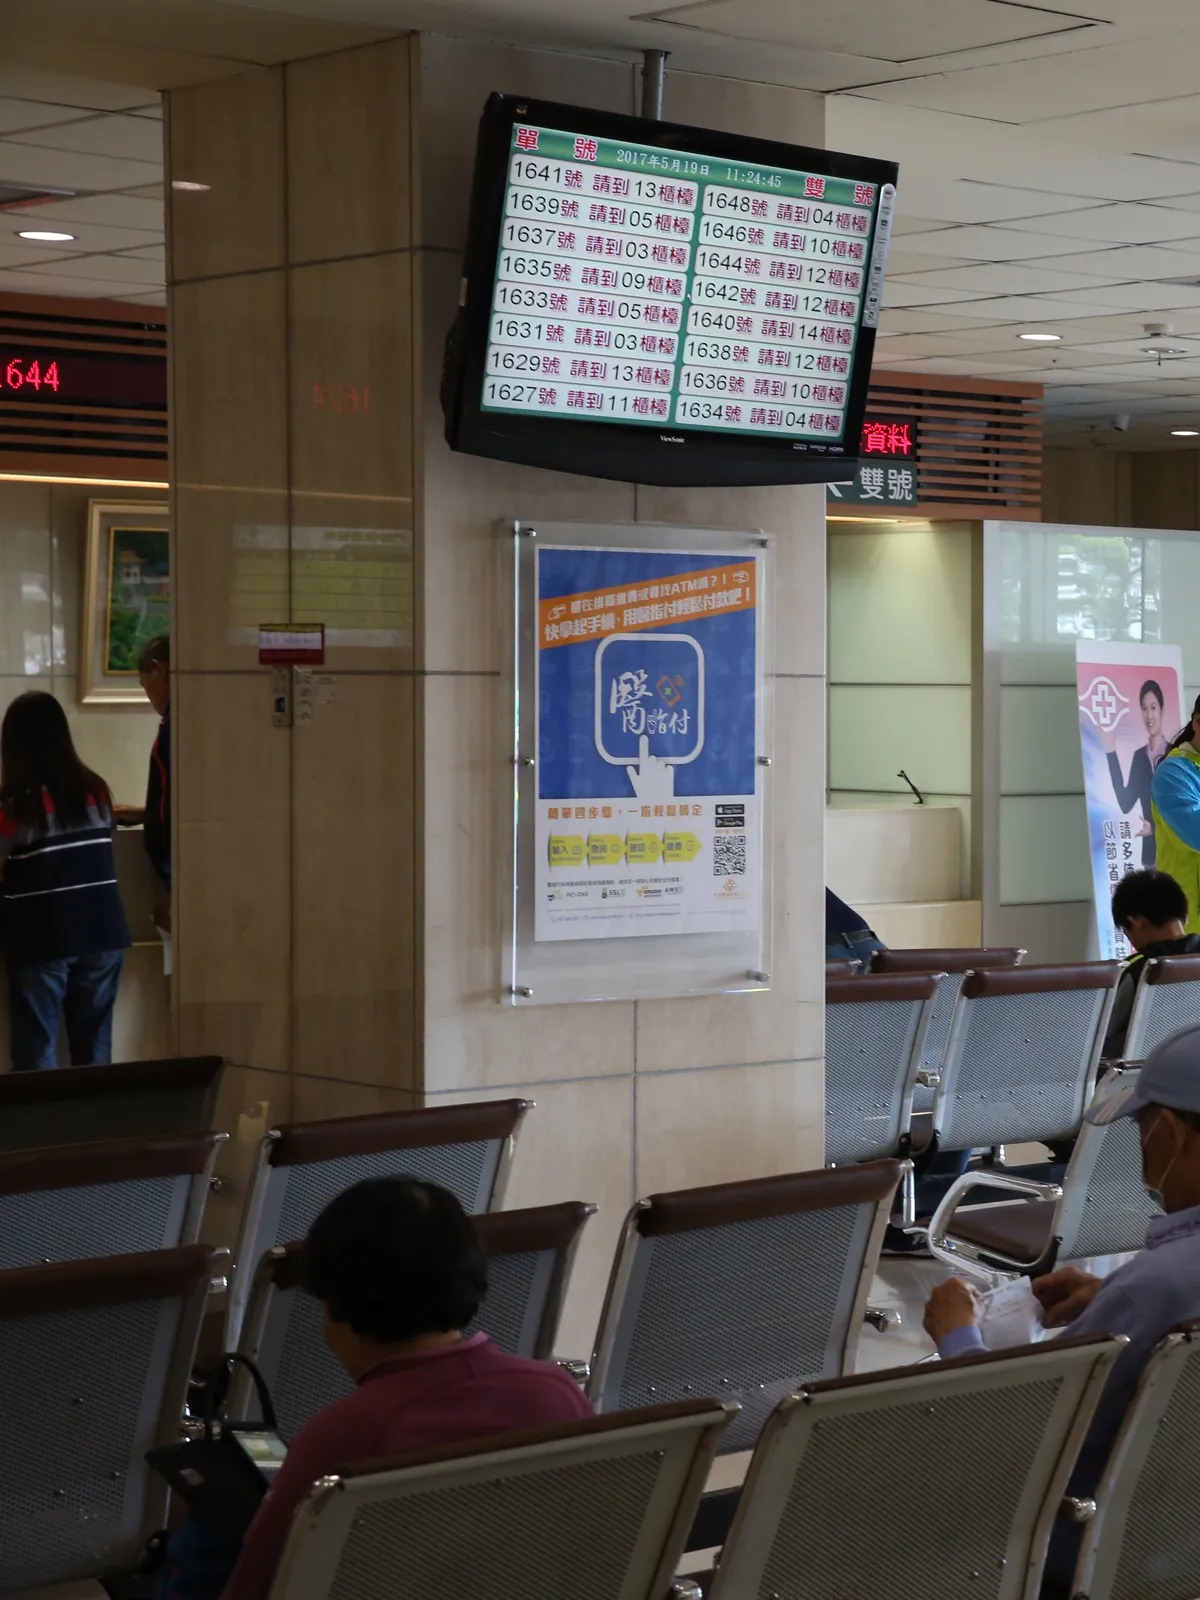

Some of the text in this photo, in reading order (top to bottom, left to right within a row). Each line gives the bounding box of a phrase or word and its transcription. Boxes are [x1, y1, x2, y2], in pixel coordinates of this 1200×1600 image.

[514, 127, 599, 162] 單號
[514, 161, 583, 189] 1641號
[617, 150, 782, 188] 2017年5月19日 11:24:45
[804, 176, 875, 206] 雙號
[510, 193, 579, 218] 1639號
[707, 192, 768, 217] 1648號
[507, 225, 576, 249] 1637號
[703, 222, 764, 245] 1646號
[503, 256, 571, 282] 1635號
[699, 252, 761, 275] 1644號
[499, 288, 567, 312] 1633號
[695, 282, 756, 305] 1642號
[495, 319, 564, 343] 1631號
[691, 311, 752, 333] 1640號
[492, 352, 560, 374] 1629號
[687, 342, 749, 363] 1638號
[0, 359, 60, 392] 644
[684, 371, 745, 393] 1636號
[488, 383, 556, 405] 1627號
[680, 402, 741, 422] 1634號
[861, 422, 912, 454] 資料
[859, 466, 912, 501] 雙號
